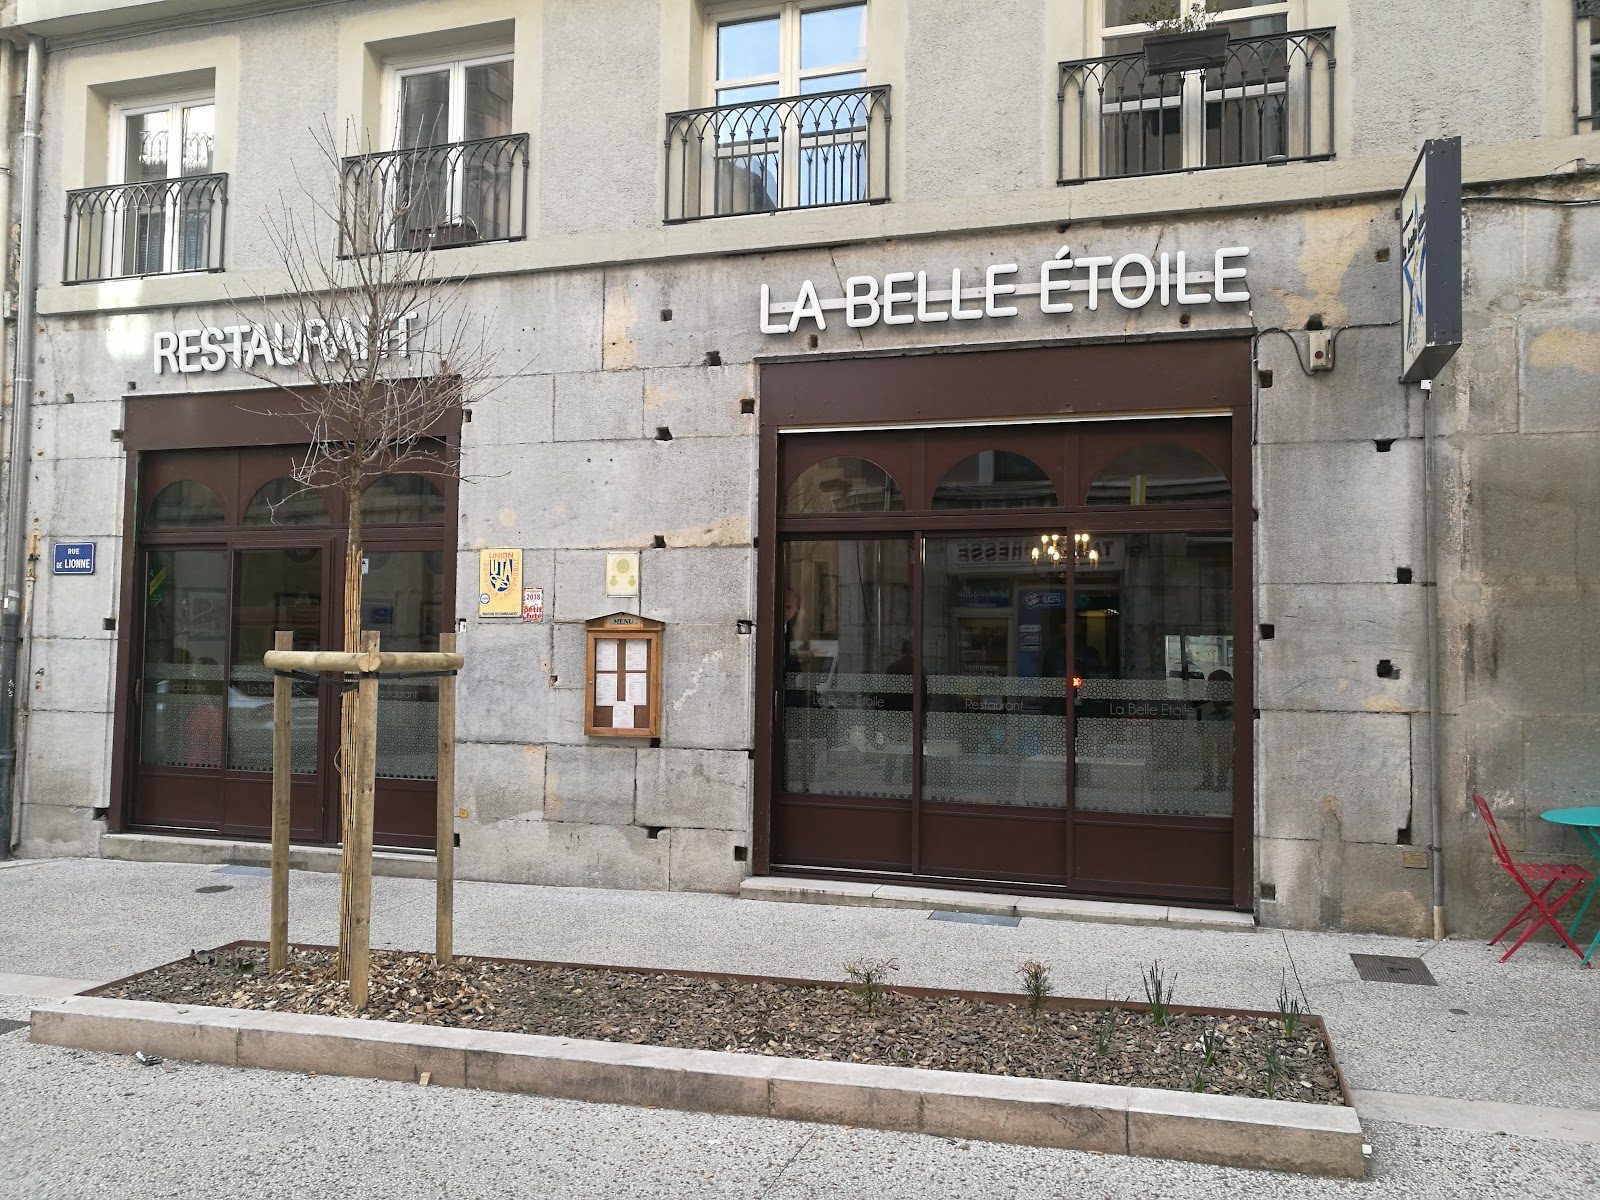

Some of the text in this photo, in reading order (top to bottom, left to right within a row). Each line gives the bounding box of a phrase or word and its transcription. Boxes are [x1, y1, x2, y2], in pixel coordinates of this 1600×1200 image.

[760, 244, 1251, 335] LA BELLE ÉTOILE
[67, 547, 80, 555] RUE
[56, 558, 91, 569] DE LIONNE
[526, 593, 541, 601] 2018
[965, 698, 1024, 711] Restaurant
[1109, 702, 1125, 714] La
[1128, 702, 1158, 715] Belle
